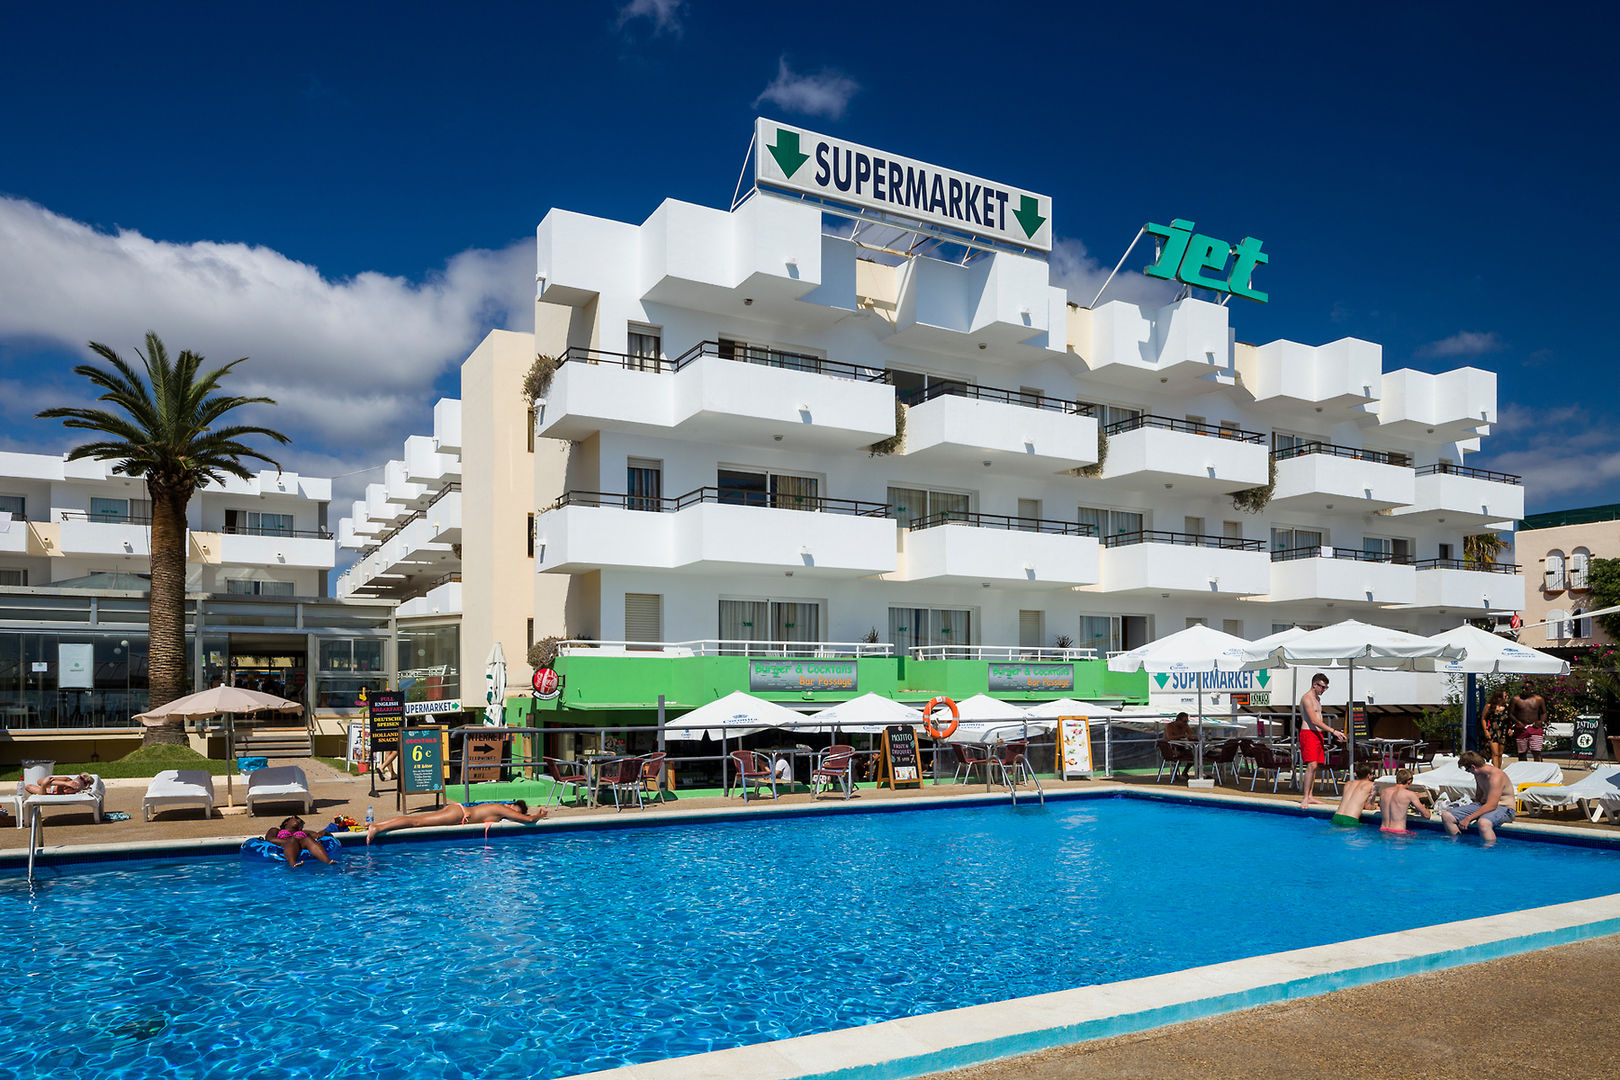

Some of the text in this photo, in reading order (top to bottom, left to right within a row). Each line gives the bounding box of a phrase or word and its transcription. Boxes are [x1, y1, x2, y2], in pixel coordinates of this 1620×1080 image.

[814, 141, 1009, 231] SUPERMARKET
[1143, 217, 1269, 303] jet
[755, 662, 853, 677] Burger & Cocktails
[992, 665, 1021, 679] Burger
[1033, 666, 1070, 676] Cocktails
[799, 676, 853, 688] Bar Passage
[1027, 677, 1070, 688] Bar Passage
[405, 702, 452, 714] UPERMARKET
[891, 733, 913, 742] MOJITO
[412, 745, 423, 762] 6
